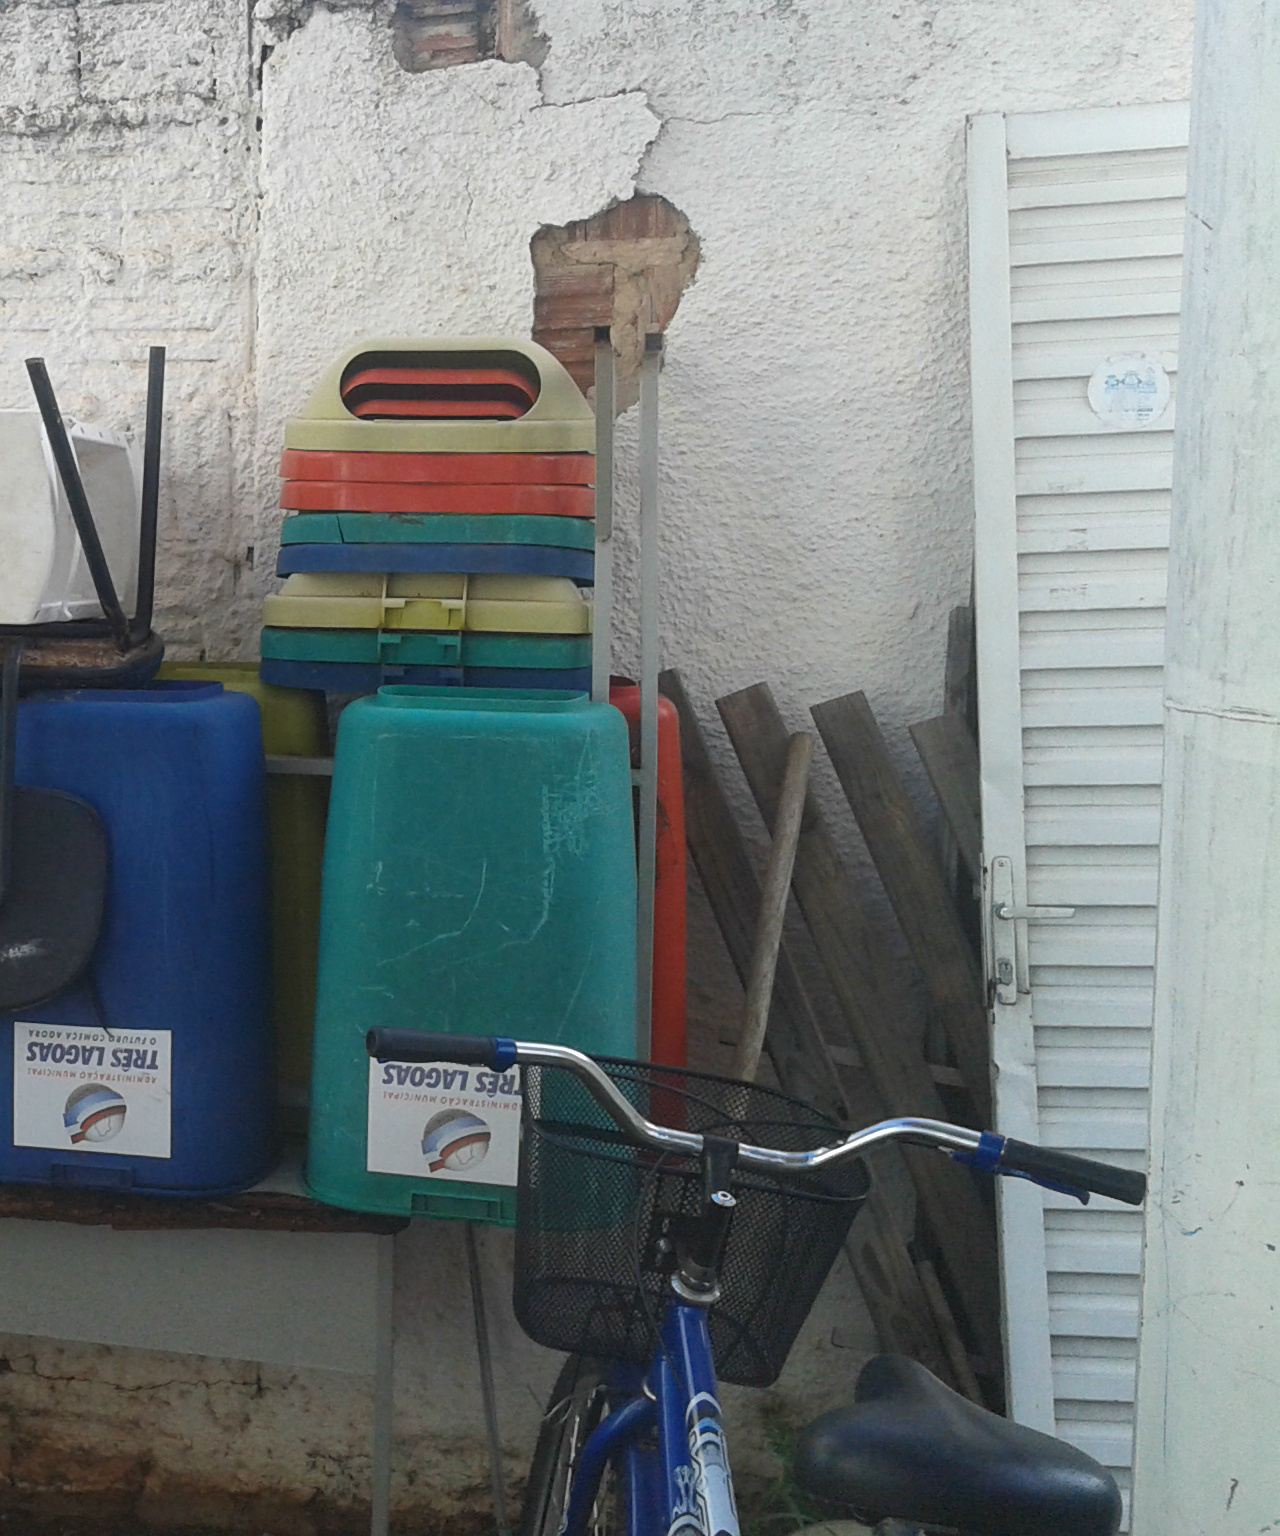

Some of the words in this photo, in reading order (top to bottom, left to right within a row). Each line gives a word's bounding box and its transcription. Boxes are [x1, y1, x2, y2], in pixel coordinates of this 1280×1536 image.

[28, 1029, 62, 1039] AGORA
[65, 1032, 105, 1042] COMEÇA
[109, 1035, 147, 1044] FUTURO
[26, 1041, 105, 1066] LAGOAS
[111, 1048, 158, 1072] TRÊS
[27, 1068, 76, 1078] MUNICIPAL
[79, 1071, 157, 1084] ADMINISTRAÇÃO
[382, 1064, 468, 1091] LAGOAS
[383, 1092, 437, 1103] MUNICIPAL
